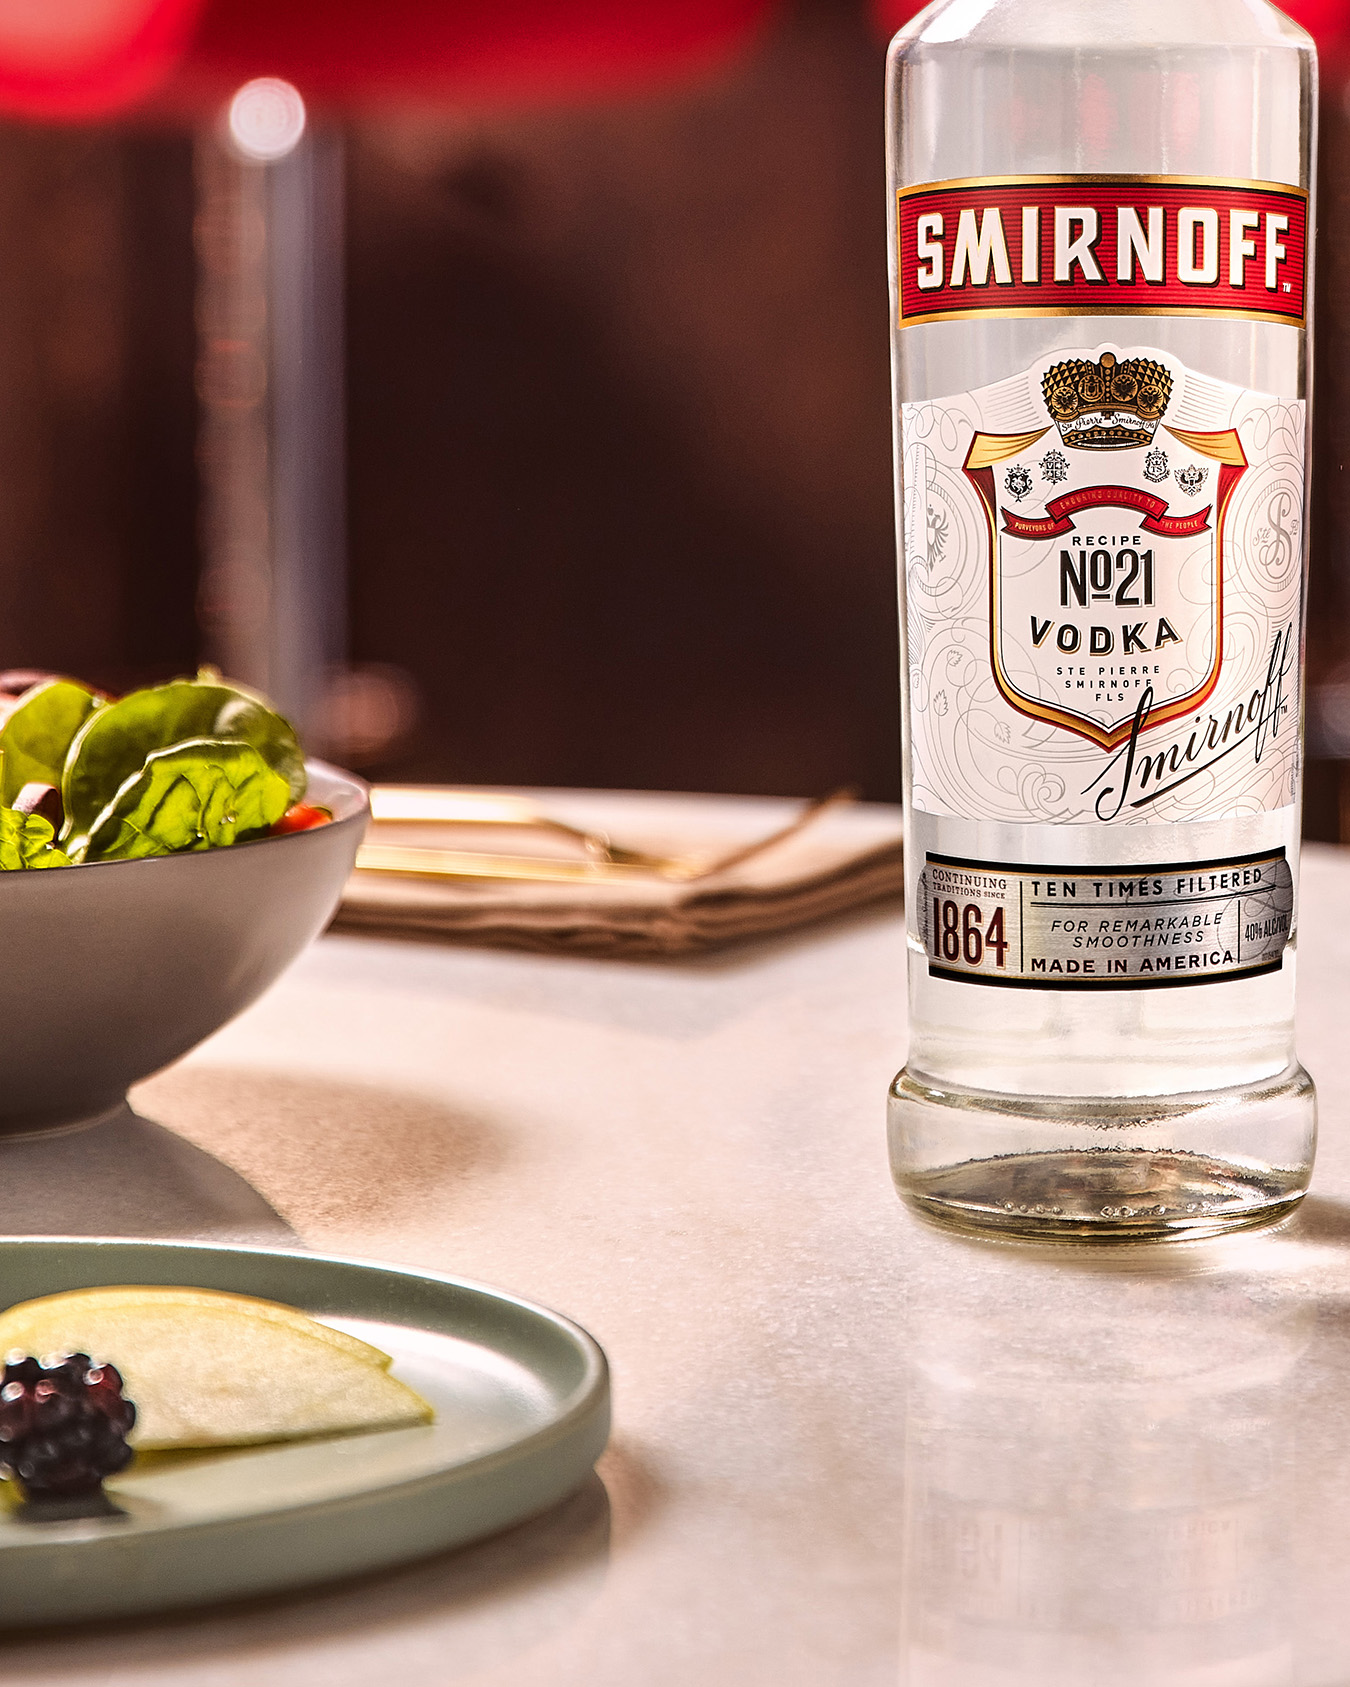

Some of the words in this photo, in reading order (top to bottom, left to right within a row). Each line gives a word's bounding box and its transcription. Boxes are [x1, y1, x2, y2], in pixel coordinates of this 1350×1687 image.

[916, 205, 1290, 291] SMIRNOFF
[1145, 497, 1156, 509] TO
[1014, 522, 1046, 532] PURVEYORS
[1175, 520, 1199, 530] PEOPLE
[1072, 535, 1142, 546] RECIPE
[1029, 615, 1183, 657] VODKA
[1056, 666, 1087, 676] STE
[1098, 664, 1161, 676] PIERRE
[1064, 678, 1153, 689] SMIRNOFF
[1095, 692, 1125, 702] FLS
[1081, 621, 1295, 821] Smirnoff
[932, 868, 1008, 890] CONTINUING
[1031, 880, 1077, 897] TEN
[1093, 879, 1163, 898] TIMES
[1177, 868, 1262, 895] FILTERED
[932, 881, 982, 898] TRADITIONS
[983, 891, 1006, 899] SINCE
[1050, 920, 1088, 933] FOR
[1099, 912, 1223, 933] REMARKABLE
[1244, 921, 1262, 942] 40%
[933, 897, 1009, 970] 1864
[1072, 930, 1205, 948] SMOOTHNESS
[1031, 958, 1095, 974] MADE
[1107, 958, 1128, 974] IN
[1139, 950, 1235, 973] AMERICA
